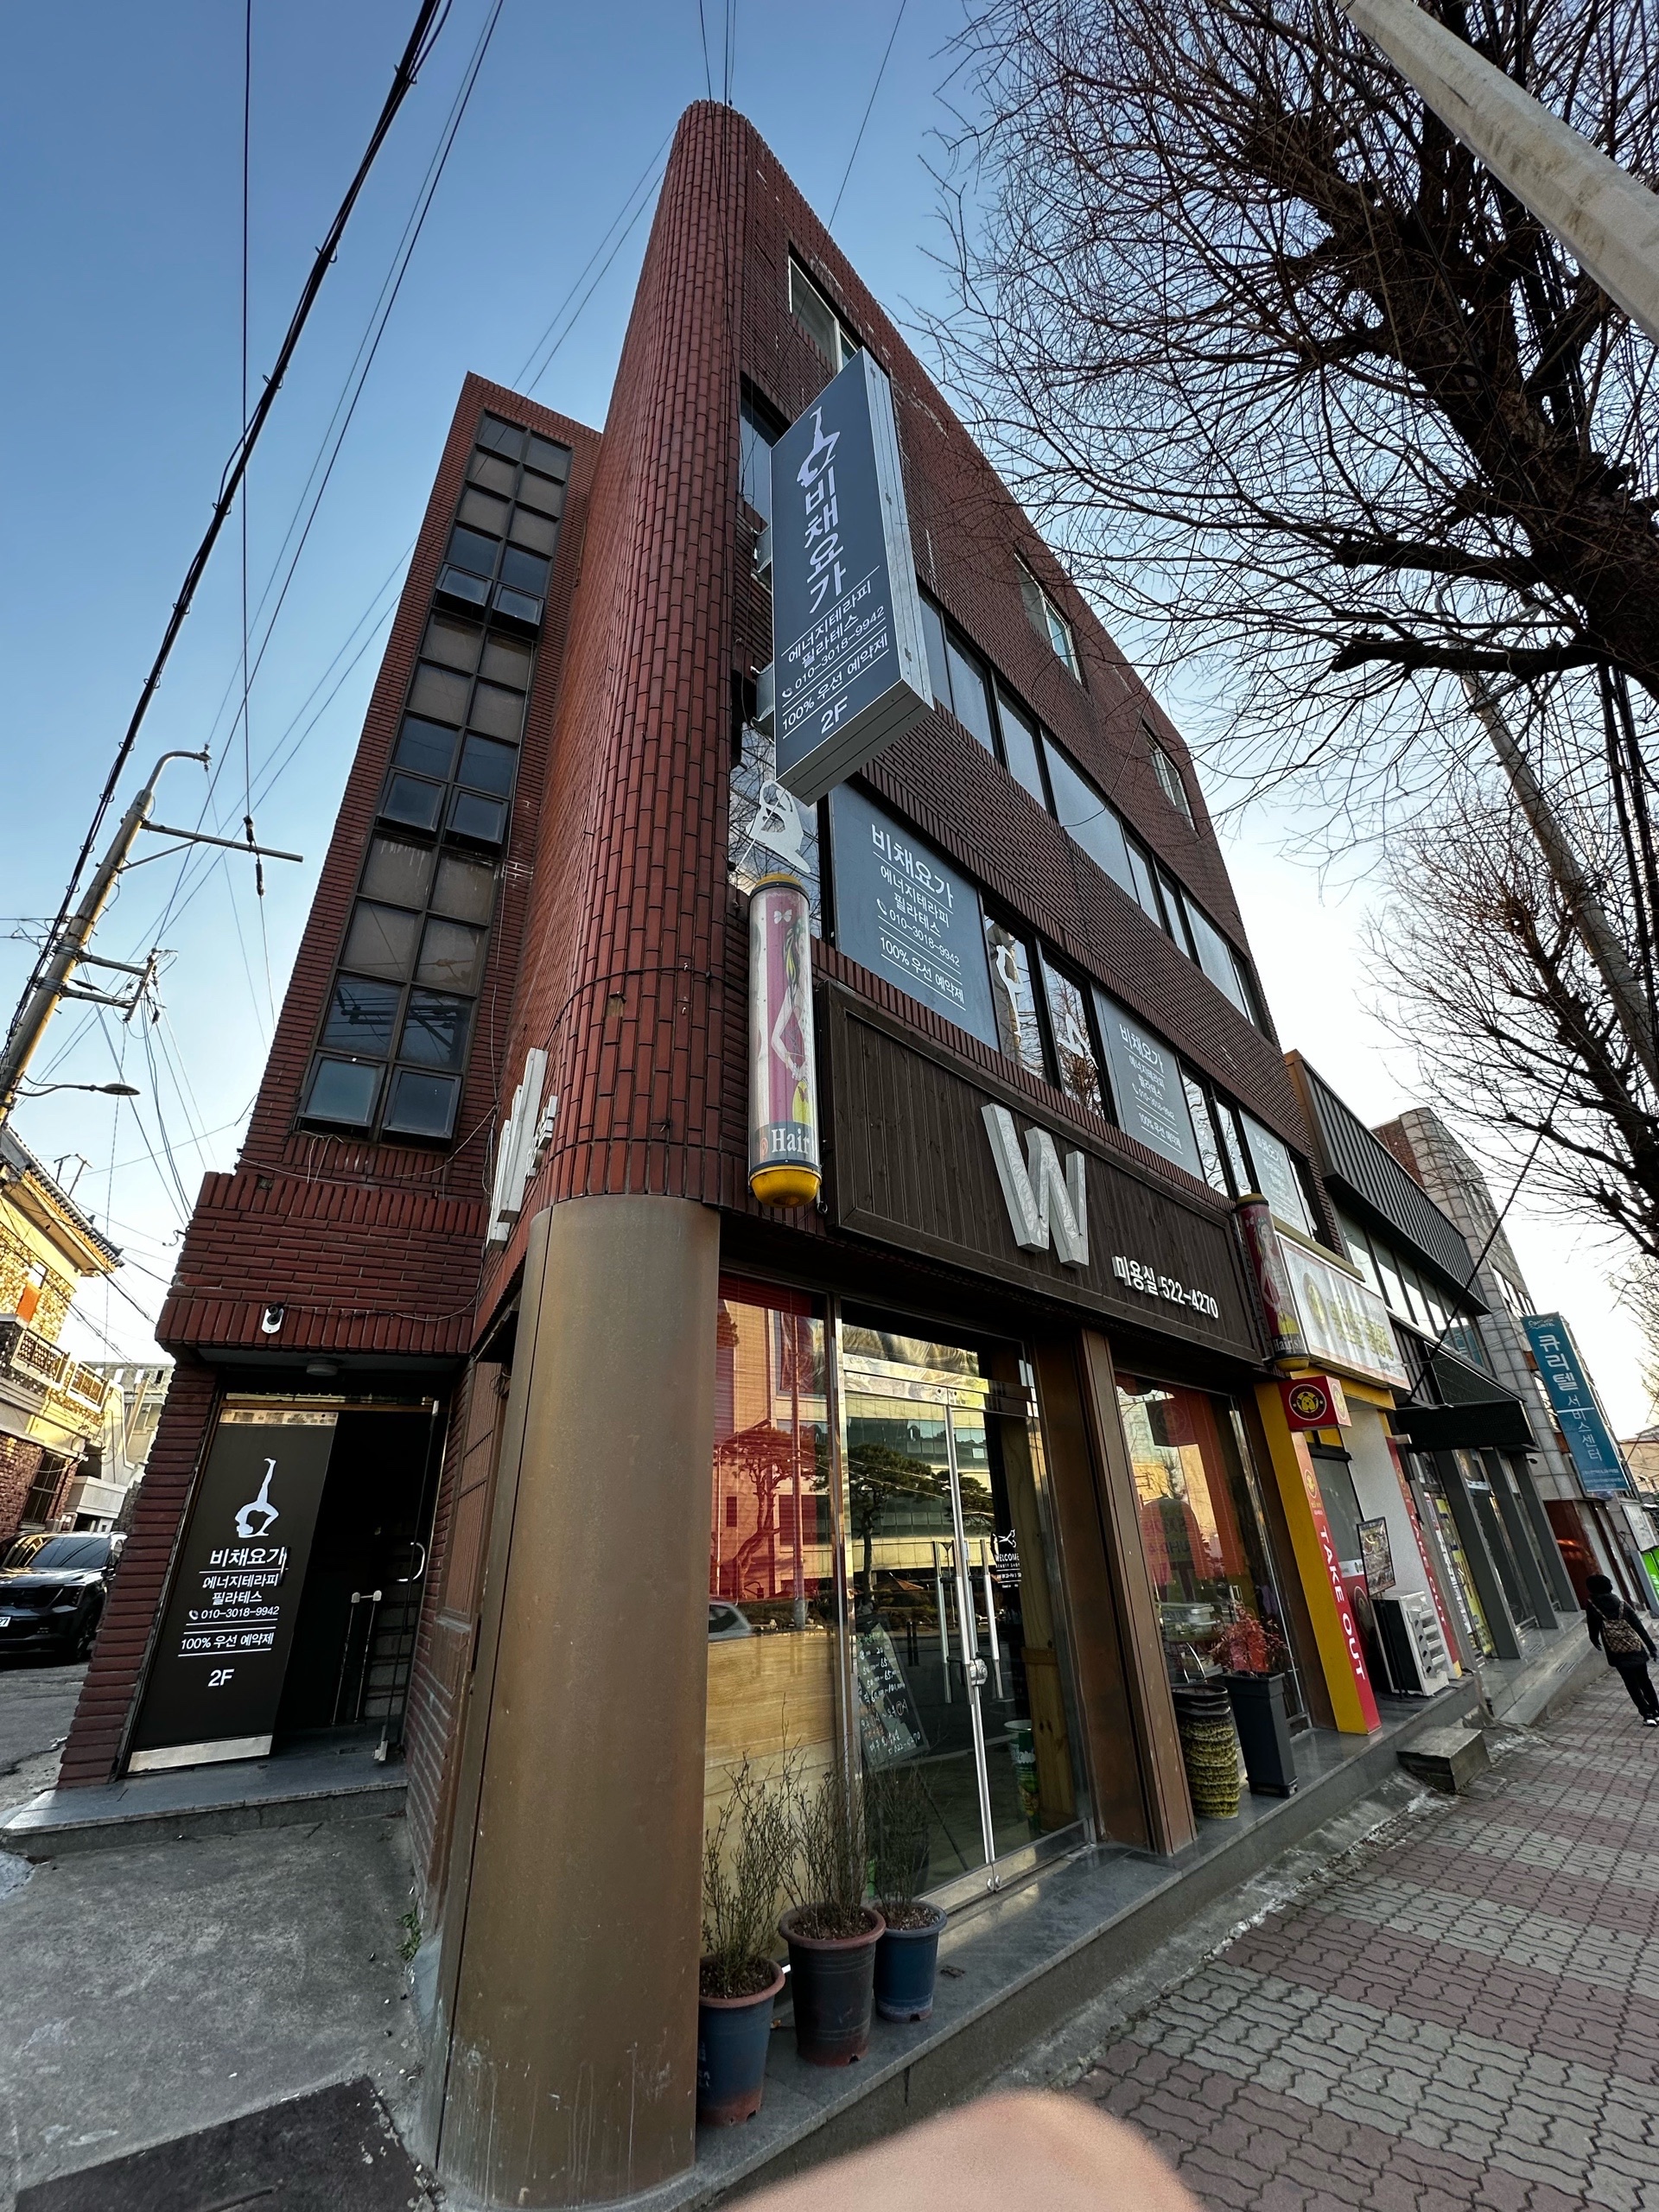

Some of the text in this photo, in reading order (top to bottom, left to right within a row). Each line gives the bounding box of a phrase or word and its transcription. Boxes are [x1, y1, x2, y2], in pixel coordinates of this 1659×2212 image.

[803, 466, 847, 614] 비채요가
[787, 584, 872, 664] 에너지테라피
[794, 605, 885, 690] 010-3018-9942
[801, 613, 860, 667] 필라테스
[782, 633, 888, 731] 100% 우선 예약제
[819, 696, 849, 734] 2F
[871, 823, 955, 909] 비채요가
[880, 865, 950, 928] 에너지테라피
[893, 892, 942, 938] 필라테스
[889, 910, 961, 968] 010-3018-9942
[880, 937, 965, 1004] 100% 우선 예약제
[1119, 1024, 1165, 1073] 비채요가
[771, 1128, 810, 1154] Hair
[1112, 1255, 1219, 1319] 미용실 522-4270
[1538, 1333, 1580, 1391] 큐리텔
[1567, 1395, 1604, 1462] 서비스센터
[202, 1573, 279, 1590] 에너지테라피
[208, 1547, 287, 1567] 비채요가
[995, 1553, 1020, 1562] WELCOME
[200, 1605, 280, 1620] 010-3018-9942
[212, 1591, 263, 1606] 필라테스
[1319, 1525, 1366, 1681] TAKE OUT
[181, 1631, 275, 1650] 100% 우선 예약제
[207, 1669, 235, 1688] 2F
